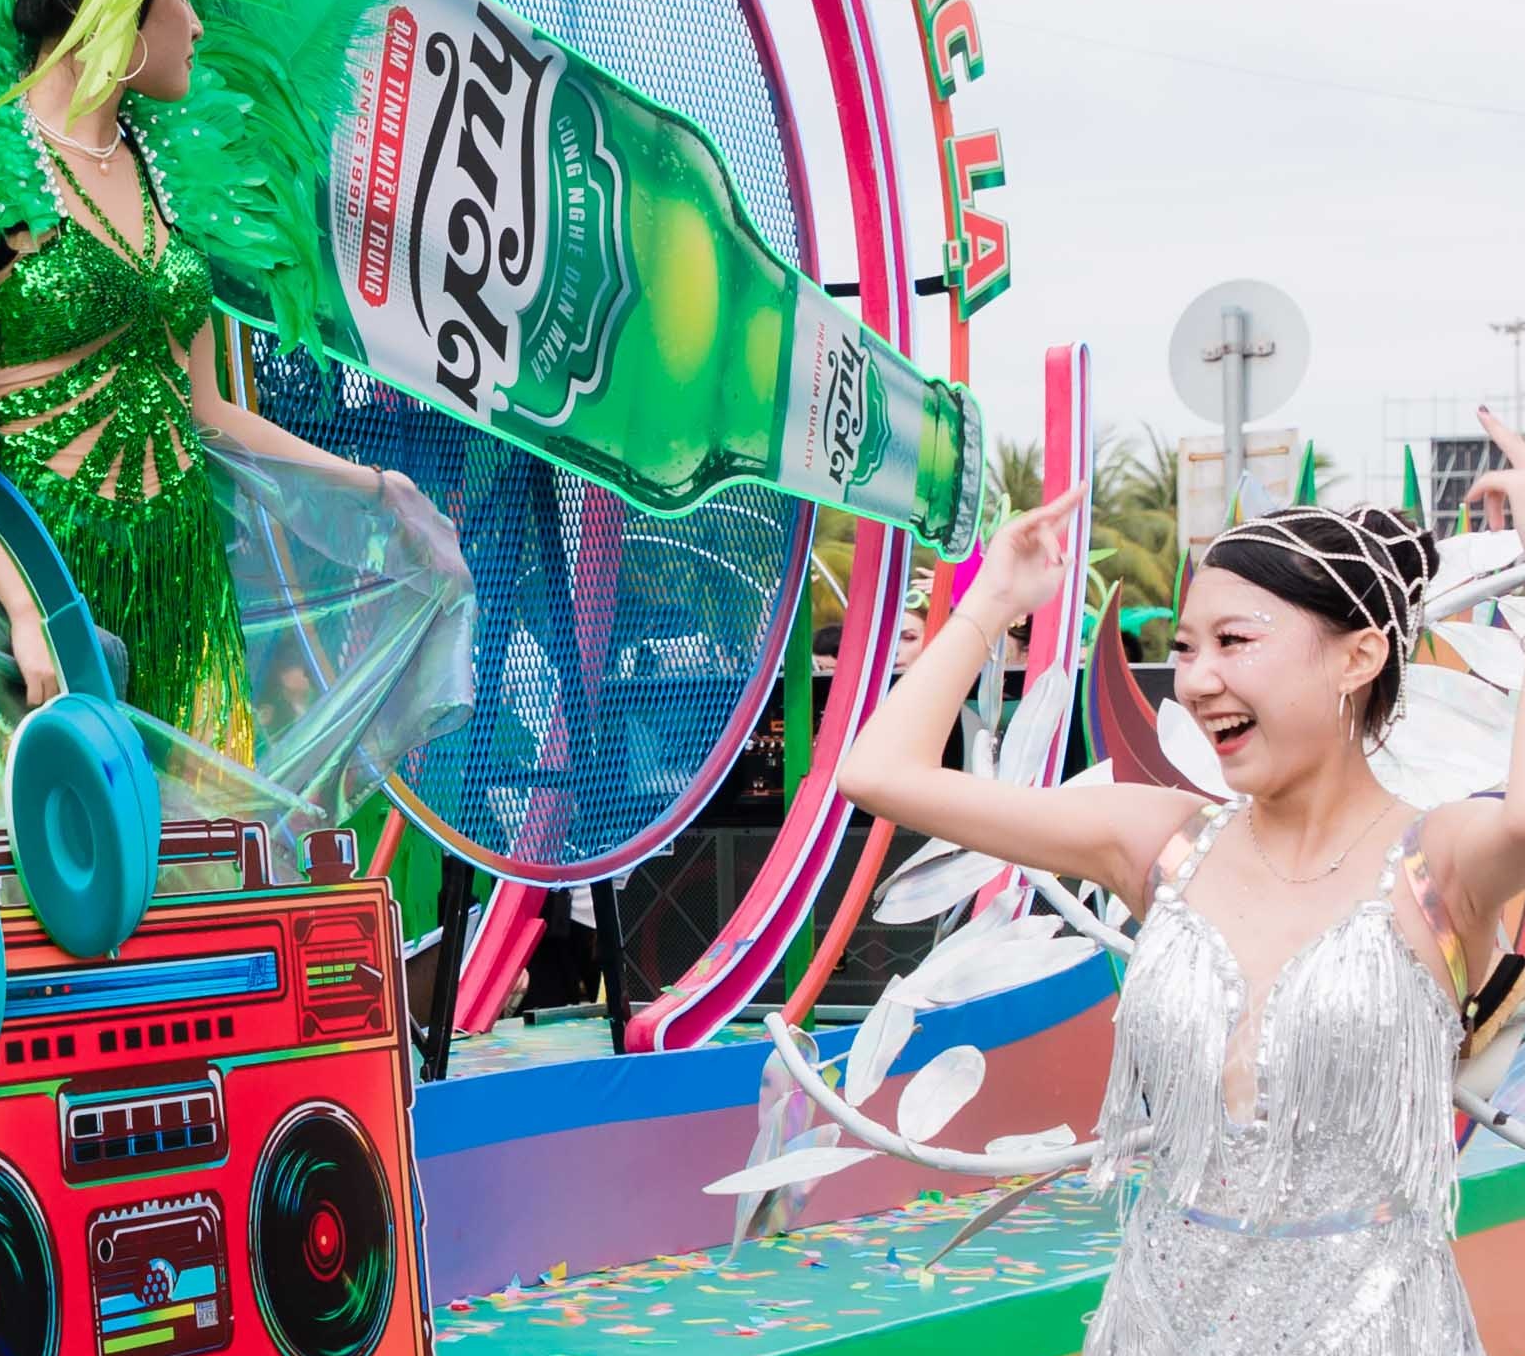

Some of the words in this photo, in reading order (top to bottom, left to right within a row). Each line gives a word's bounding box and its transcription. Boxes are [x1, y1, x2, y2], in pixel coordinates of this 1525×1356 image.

[354, 69, 374, 148] SINCE
[347, 155, 365, 220] 1990
[944, 129, 1011, 316] LẠ
[363, 219, 387, 300] TRUNG
[812, 321, 826, 398] PREMIUM
[805, 404, 818, 470] QUALITY
